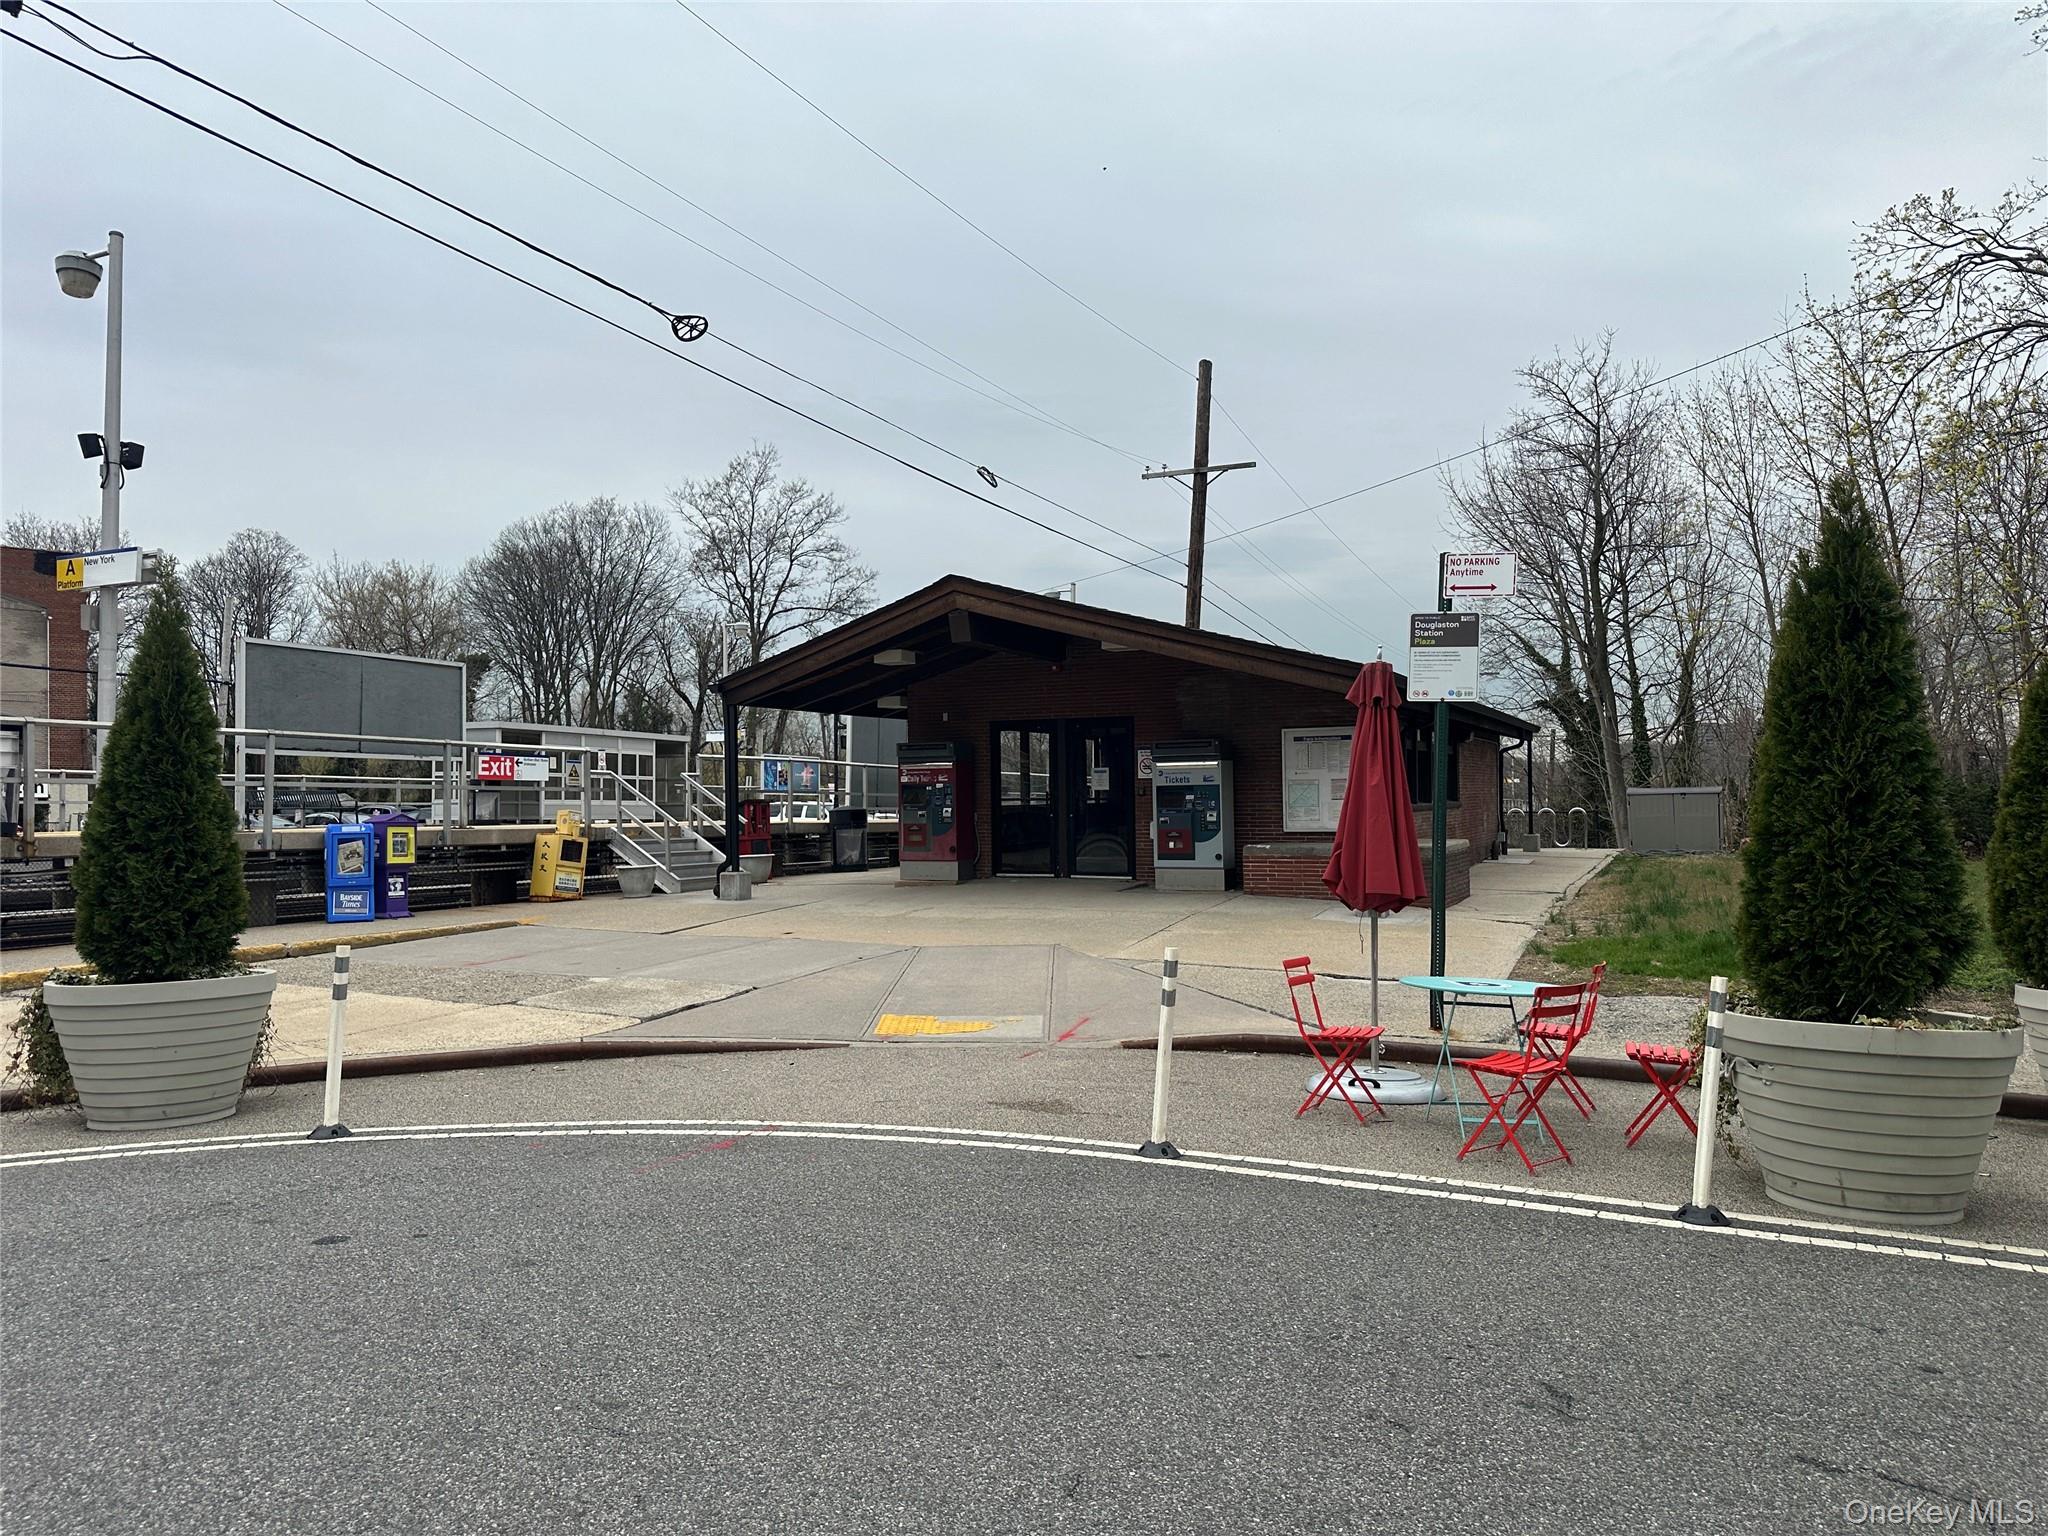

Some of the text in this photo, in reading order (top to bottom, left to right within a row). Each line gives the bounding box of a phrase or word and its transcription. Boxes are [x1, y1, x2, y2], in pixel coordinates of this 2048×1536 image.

[84, 555, 116, 566] New York
[1449, 557, 1500, 567] NO PARKING
[65, 559, 76, 576] A
[1449, 568, 1484, 577] Anytime
[57, 580, 84, 589] Platform
[1414, 620, 1460, 630] Douglaston
[1414, 629, 1444, 637] Station
[478, 756, 512, 777] Exit
[1164, 775, 1191, 784] Tickets
